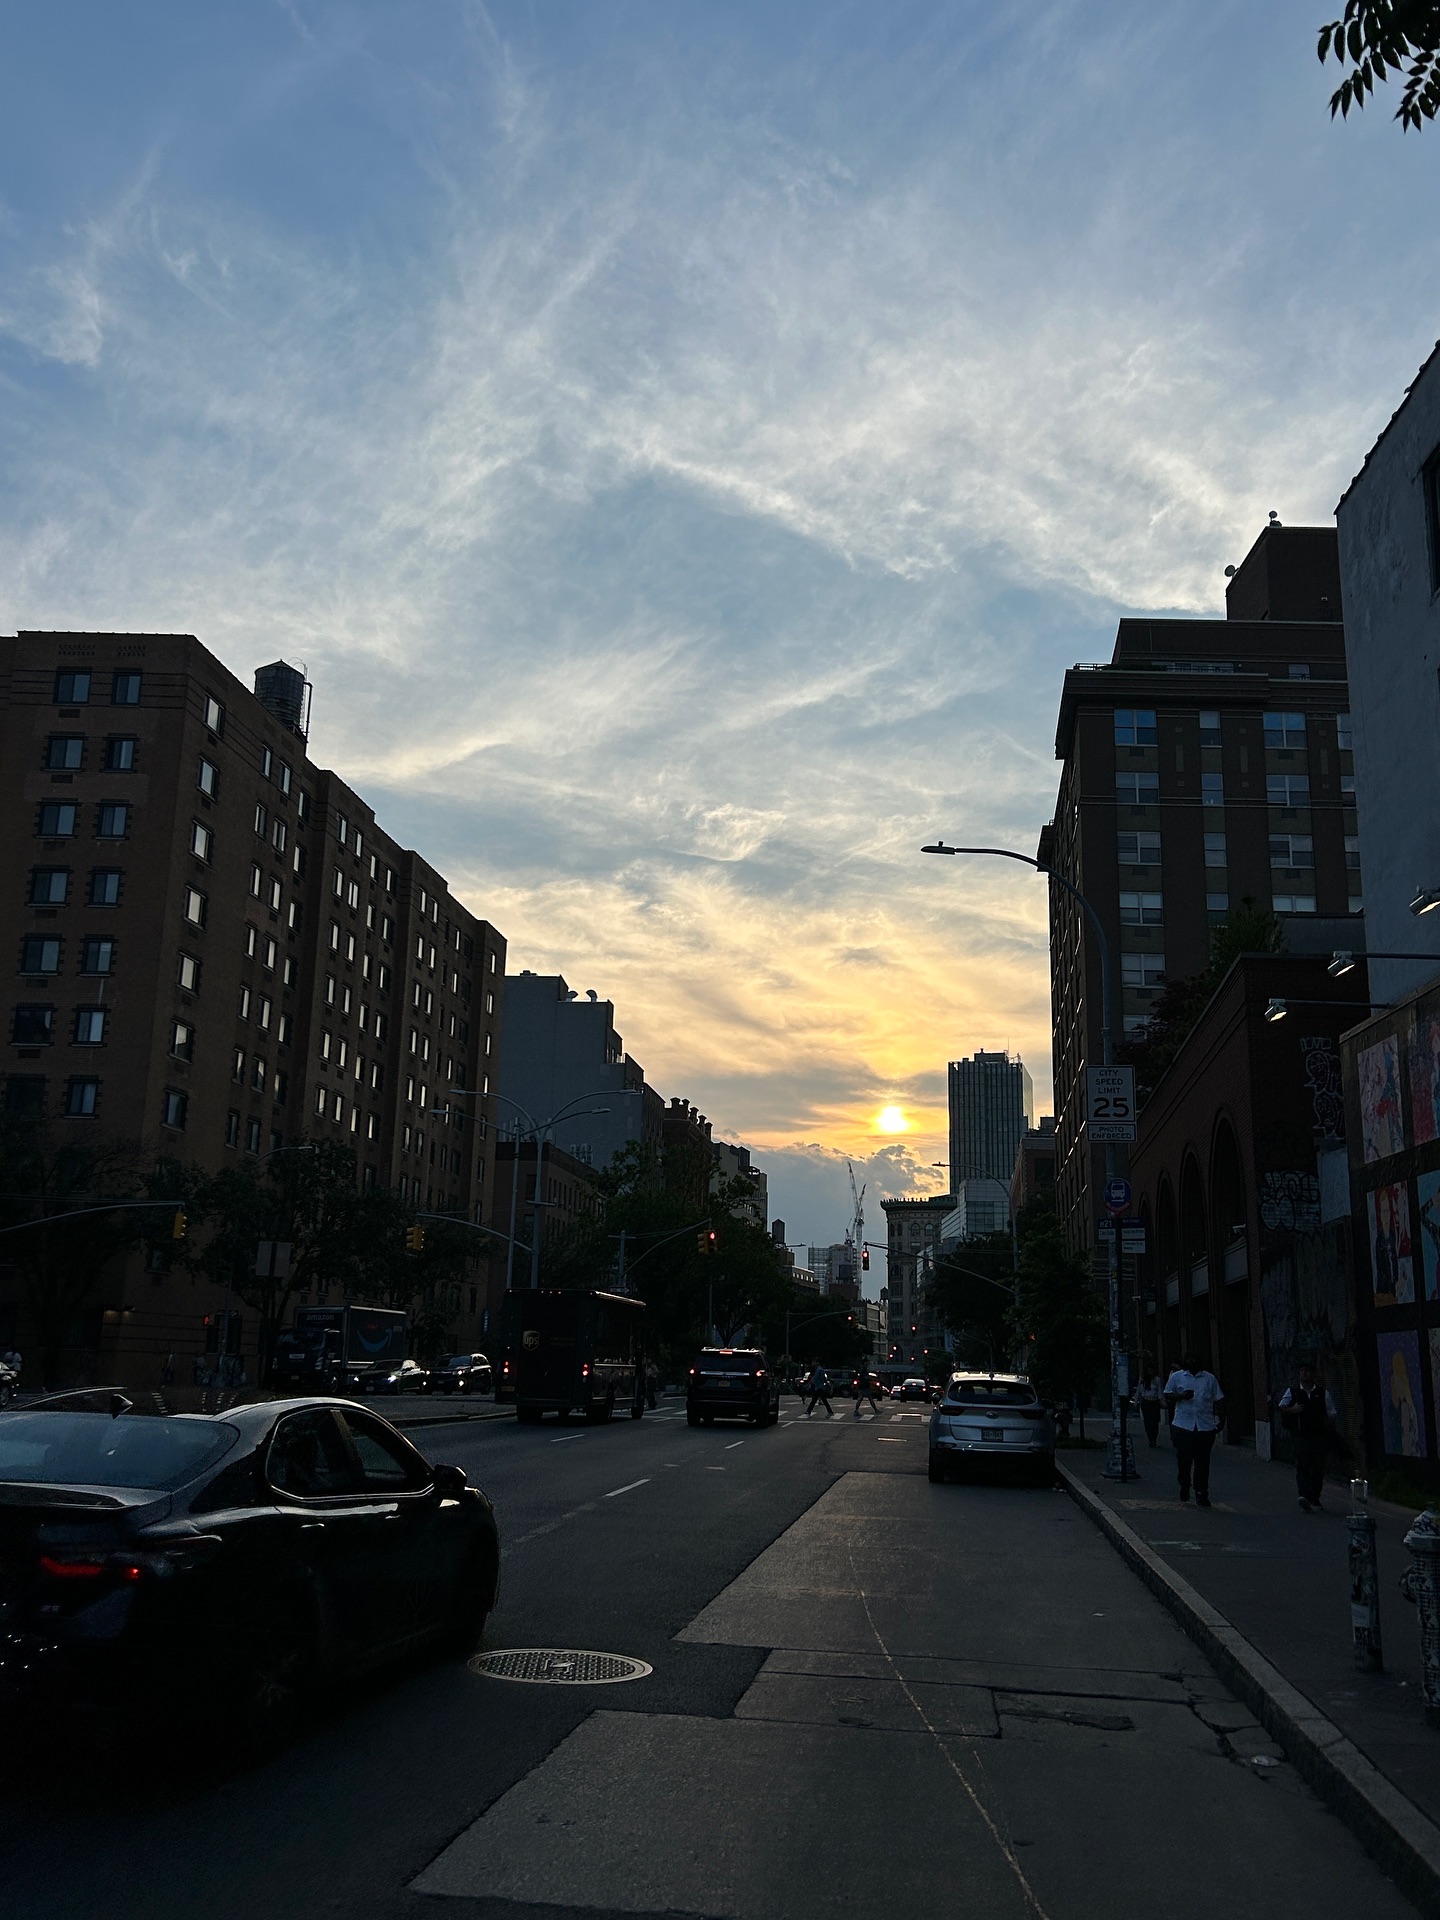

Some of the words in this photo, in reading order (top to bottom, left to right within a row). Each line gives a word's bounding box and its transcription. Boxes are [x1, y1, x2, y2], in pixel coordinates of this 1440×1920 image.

[1093, 1097, 1129, 1117] 25
[306, 1313, 335, 1321] amazon
[524, 1336, 539, 1347] ups
